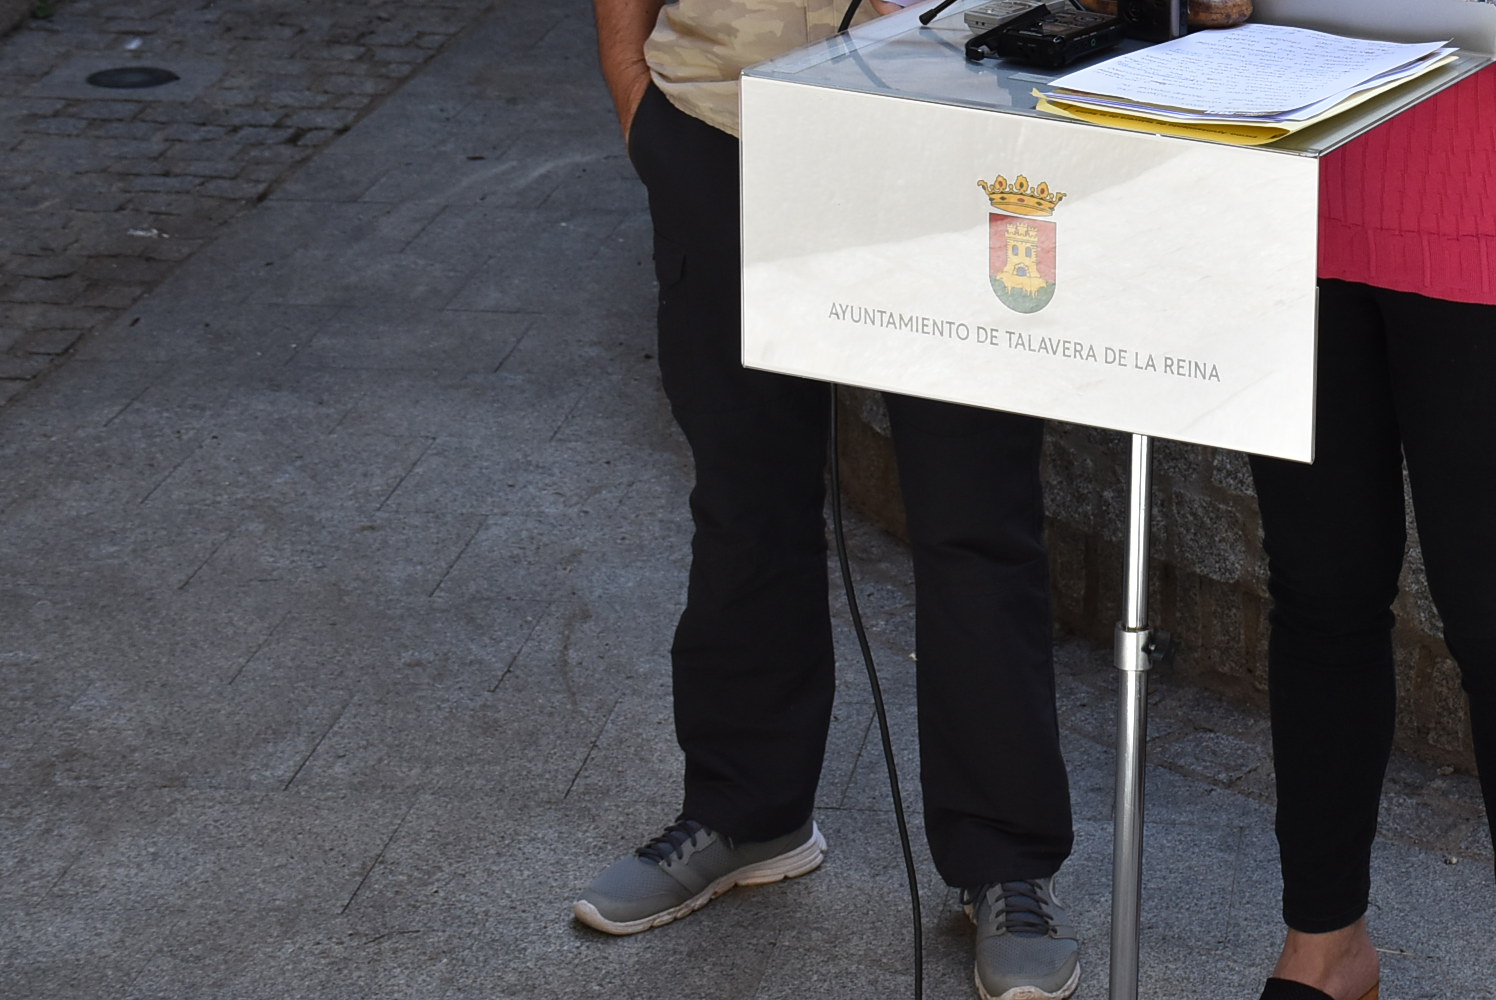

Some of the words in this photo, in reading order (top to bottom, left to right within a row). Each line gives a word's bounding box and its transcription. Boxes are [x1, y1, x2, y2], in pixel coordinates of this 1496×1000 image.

[828, 302, 970, 341] AYUNTAMIENTO
[976, 326, 999, 346] DE
[1005, 331, 1098, 362] TALAVERA
[1104, 347, 1128, 367] DE
[1134, 351, 1157, 372] LA
[1163, 356, 1221, 382] REINA
